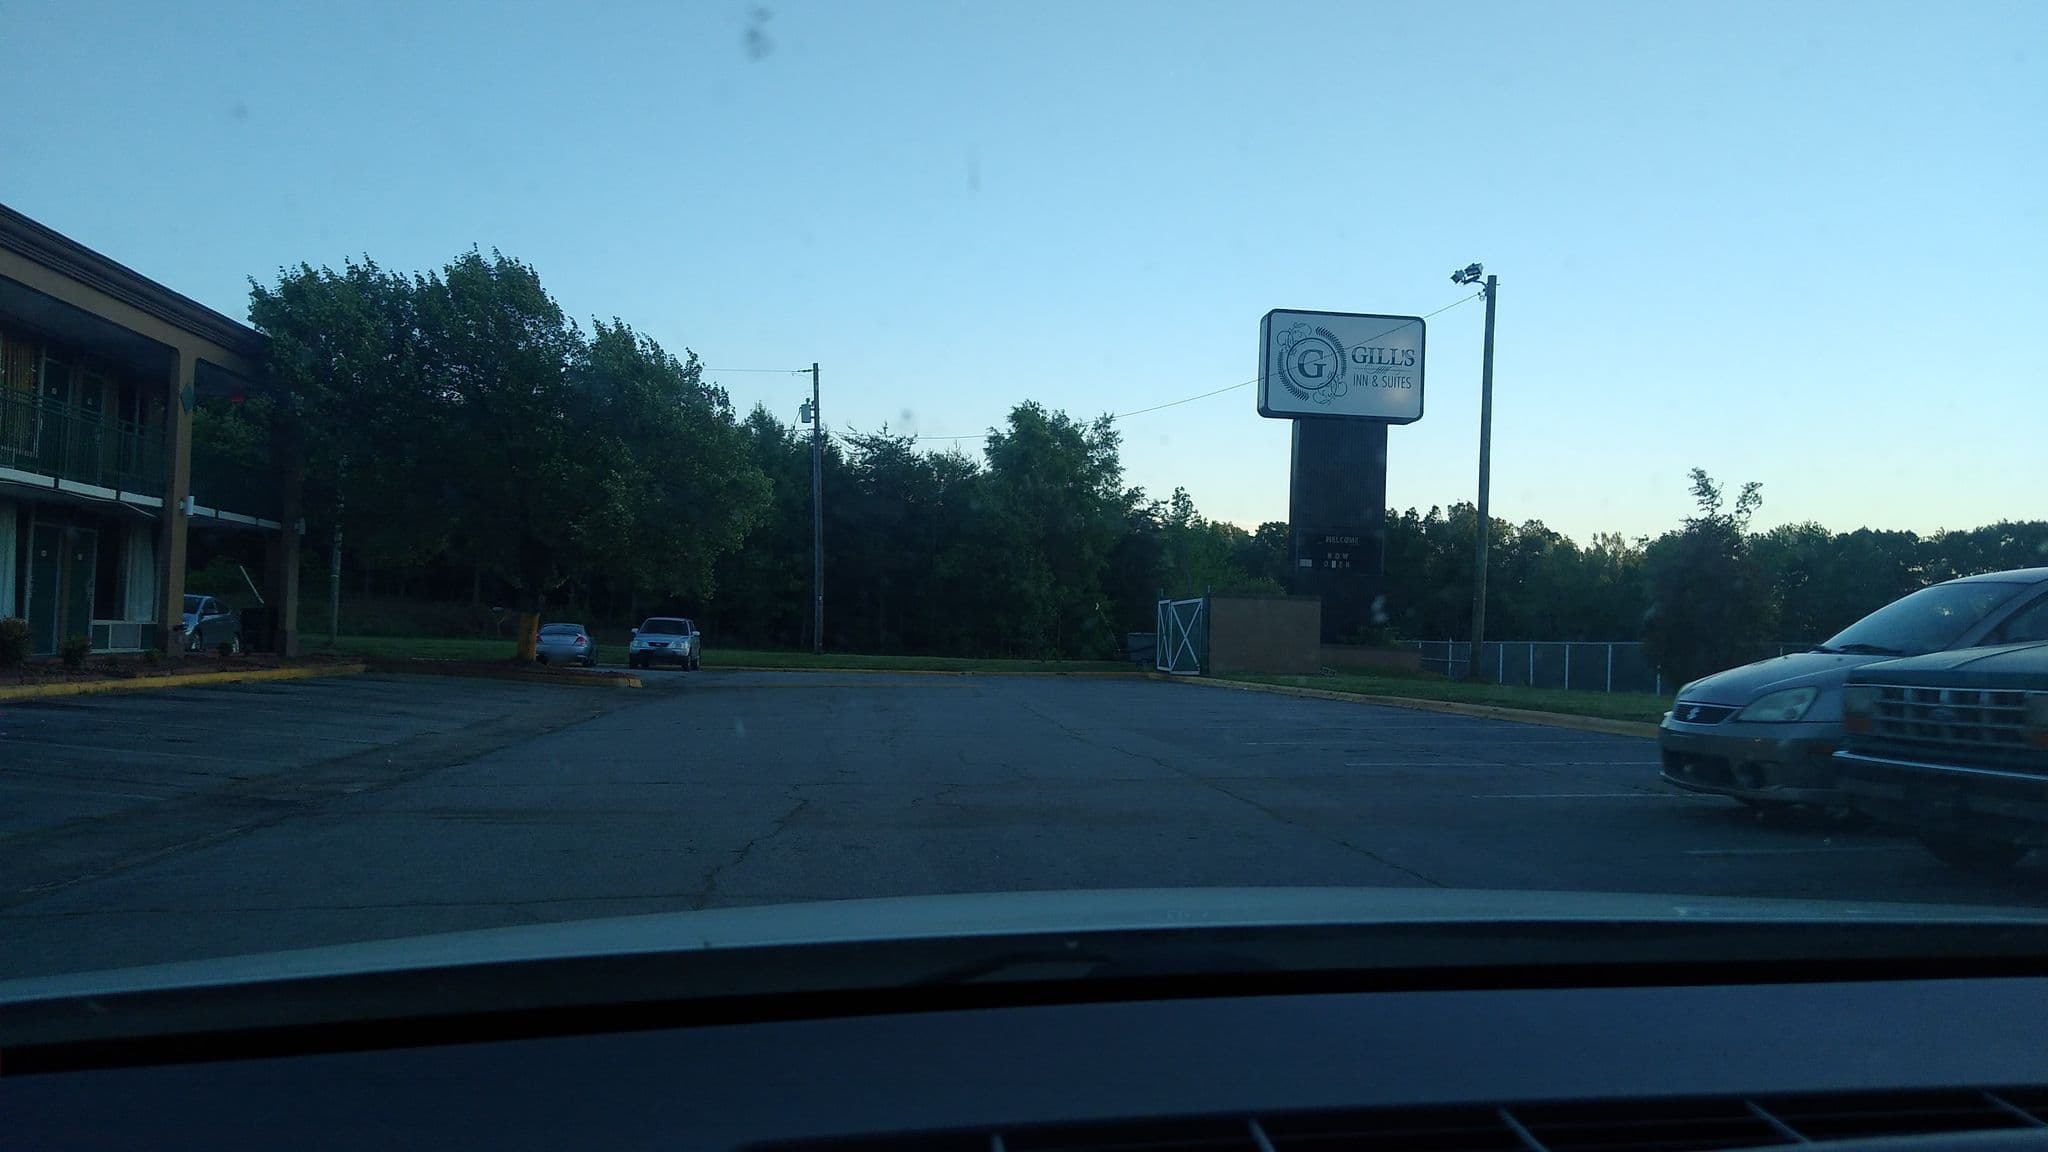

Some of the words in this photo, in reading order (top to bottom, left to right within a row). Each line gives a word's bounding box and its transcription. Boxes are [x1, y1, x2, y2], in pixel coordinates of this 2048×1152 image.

[1298, 349, 1327, 378] G
[1351, 346, 1415, 366] GILL'S
[1353, 375, 1368, 387] INN
[1372, 376, 1378, 387] &
[1382, 376, 1411, 389] SUITES
[1325, 535, 1360, 544] WELCOME
